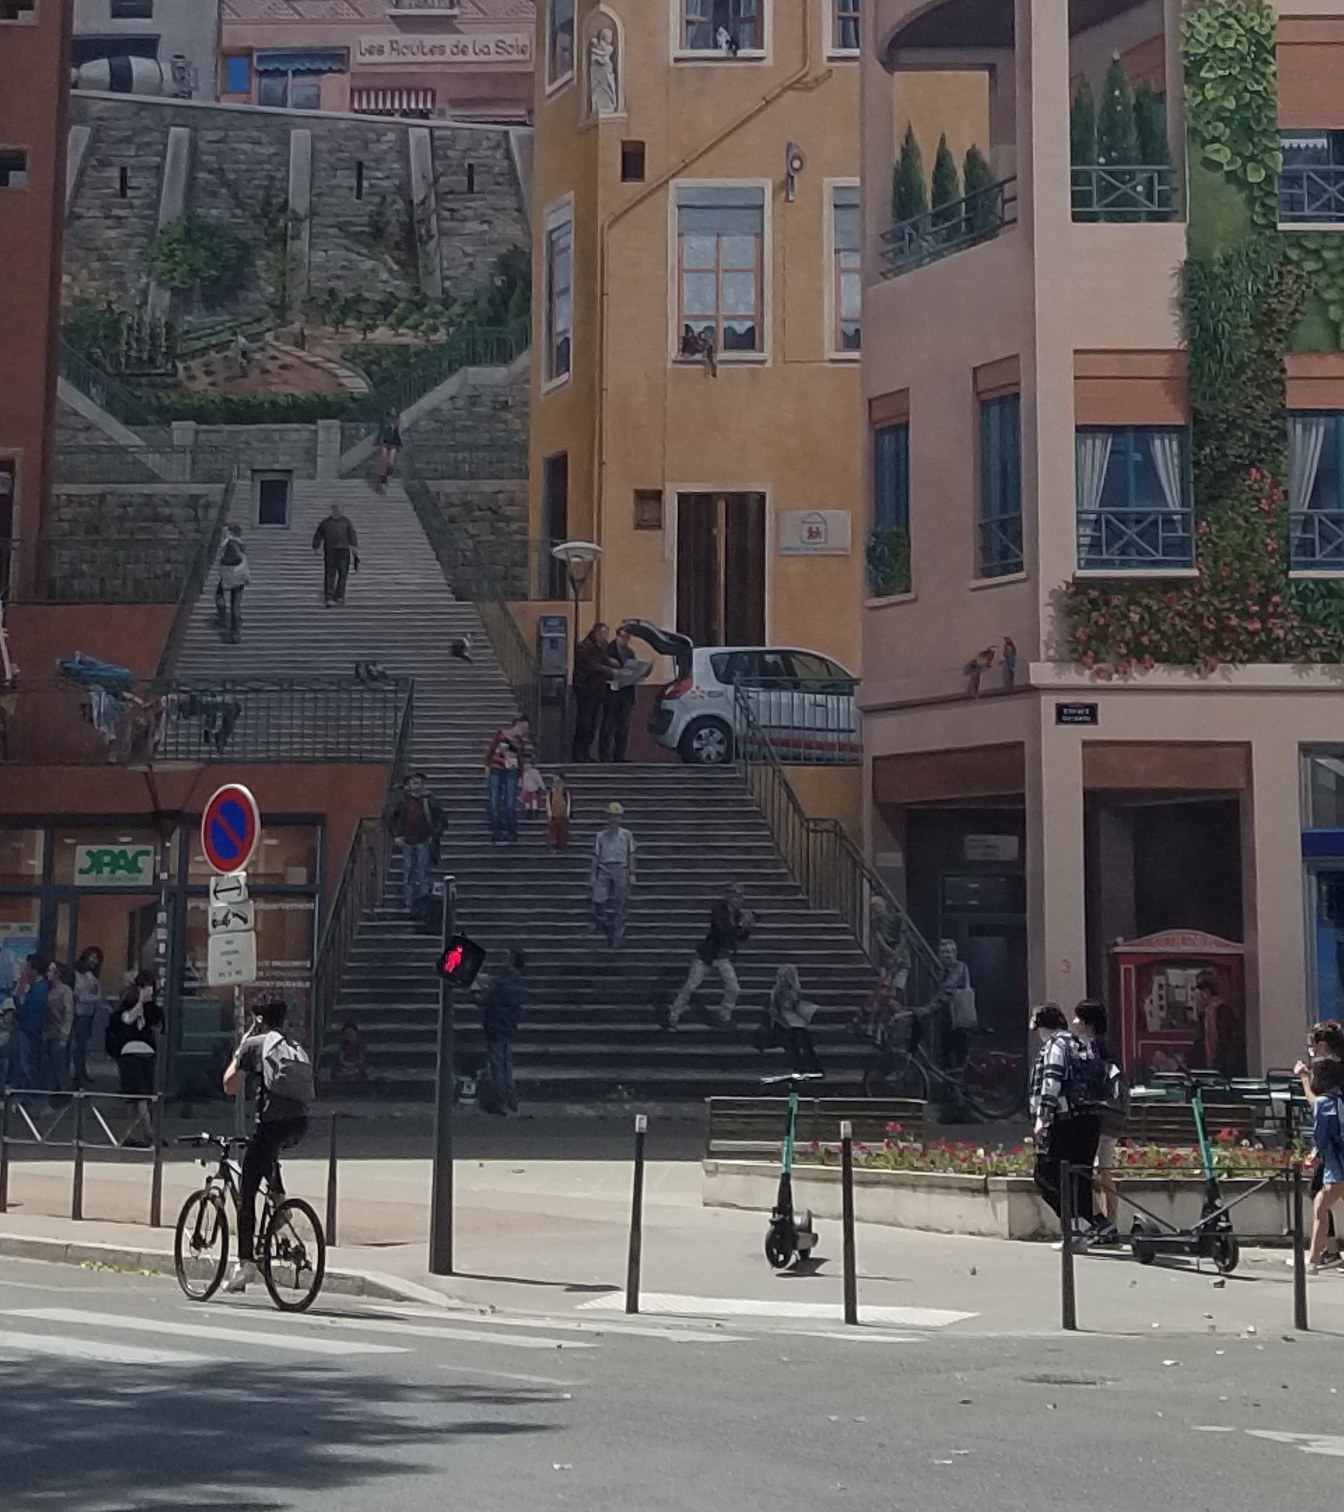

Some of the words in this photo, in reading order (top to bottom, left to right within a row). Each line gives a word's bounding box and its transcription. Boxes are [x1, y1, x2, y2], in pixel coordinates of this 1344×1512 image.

[388, 39, 447, 57] Routes
[450, 39, 470, 56] de
[495, 37, 529, 56] Soie
